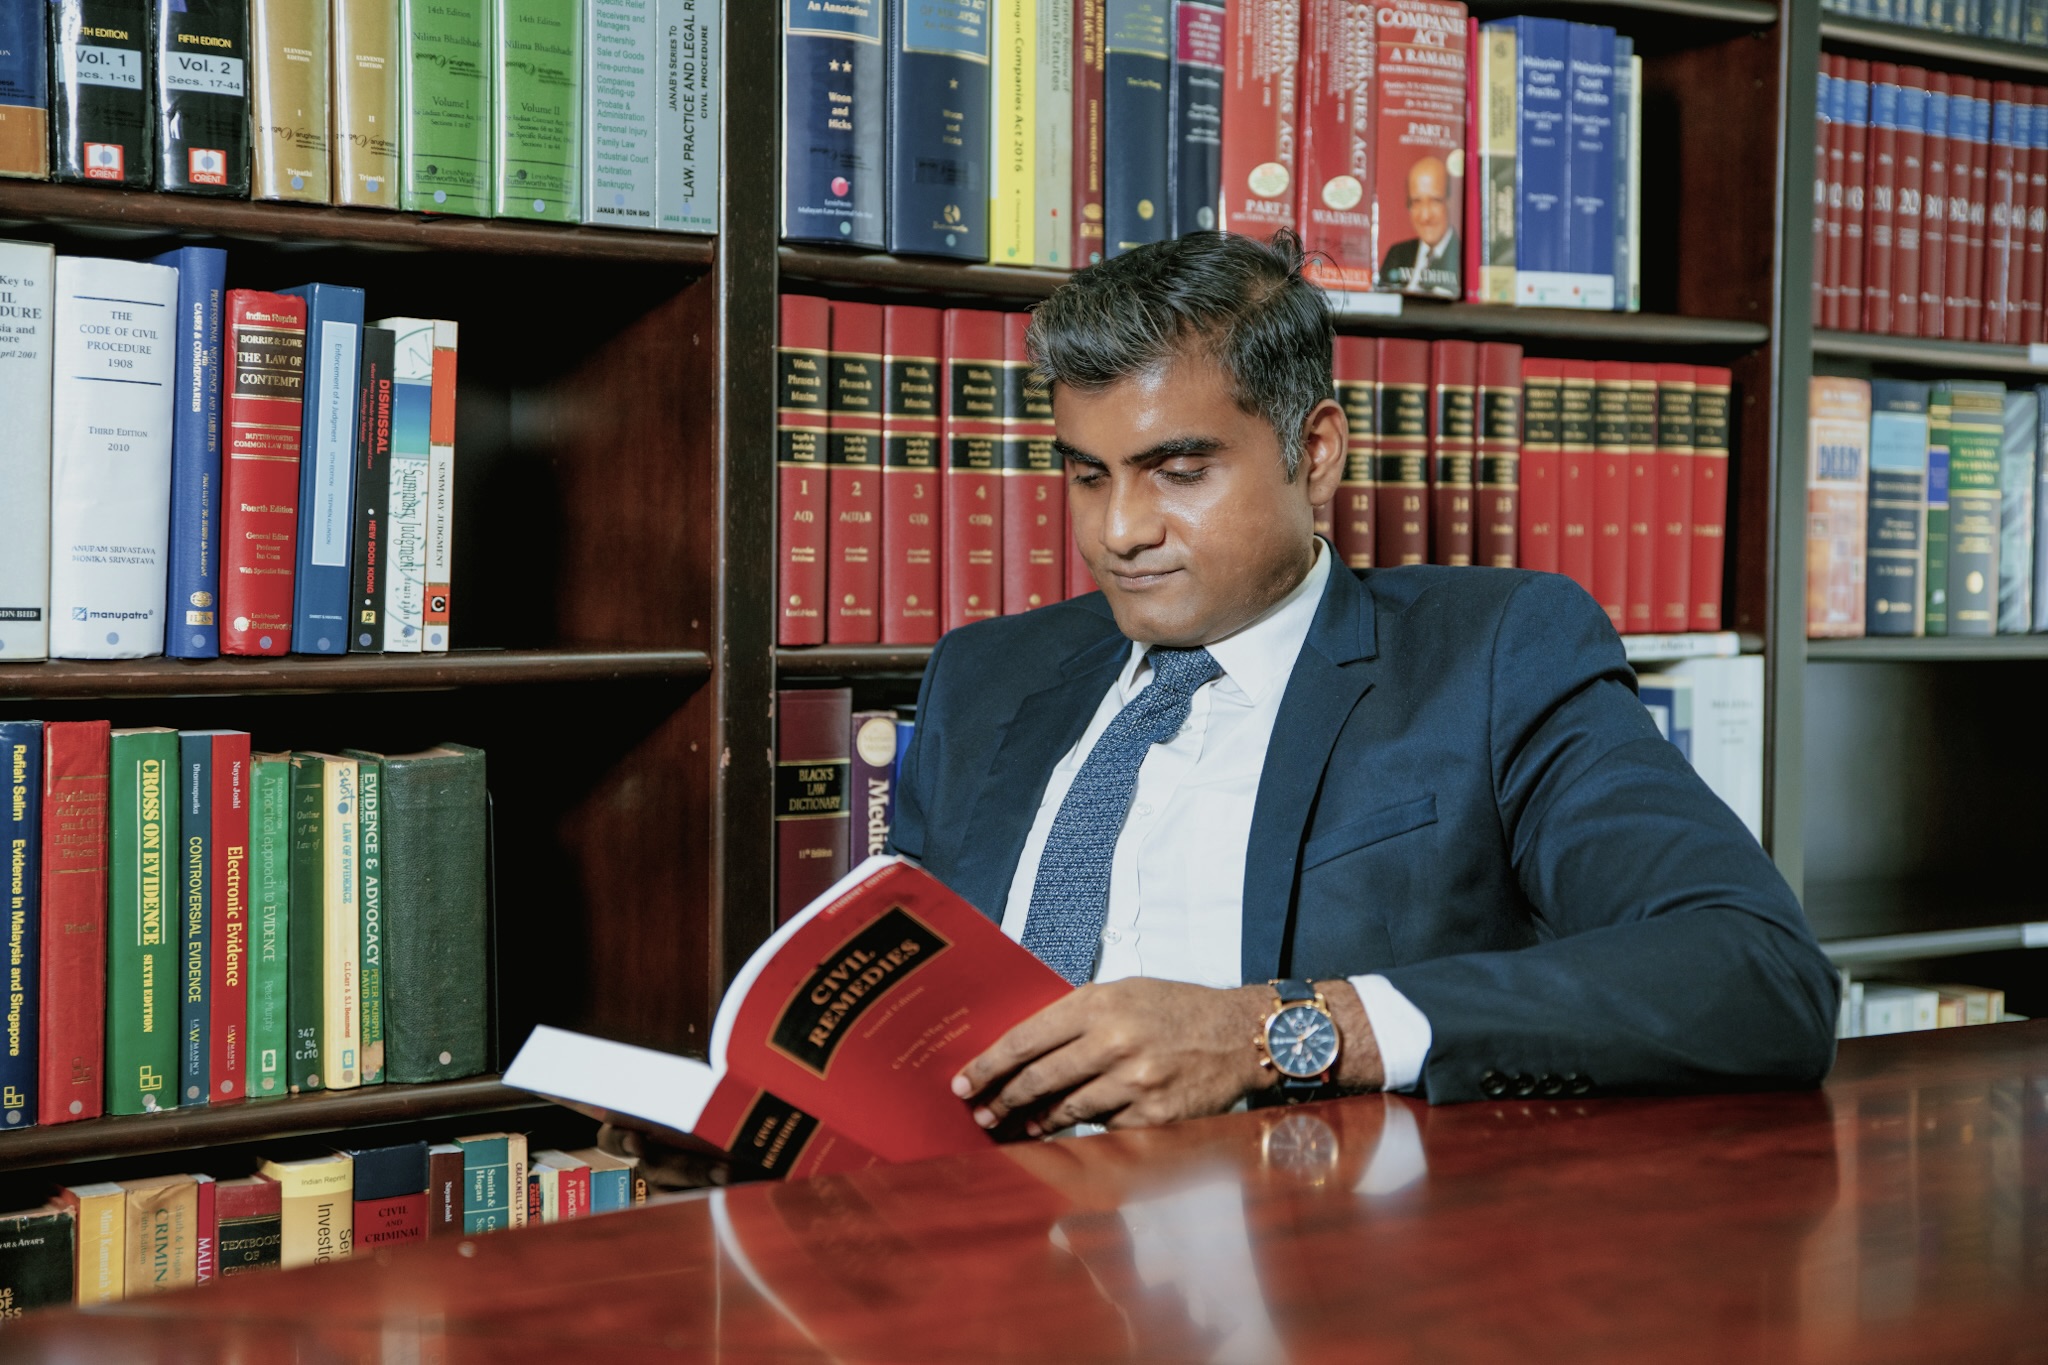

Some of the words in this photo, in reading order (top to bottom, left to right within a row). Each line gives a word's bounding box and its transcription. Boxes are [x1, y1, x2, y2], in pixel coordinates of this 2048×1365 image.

[597, 9, 631, 22] Receivers
[632, 15, 645, 24] and
[823, 2, 868, 18] Annotation
[596, 19, 630, 32] Managers
[95, 28, 128, 41] EDITION
[177, 33, 200, 45] FIFTH
[200, 35, 232, 49] EDITION
[597, 33, 636, 47] Partnership
[683, 14, 696, 59] LEGAL
[1412, 29, 1448, 49] ACT
[76, 50, 110, 66] Vol.
[118, 54, 126, 67] 1
[597, 47, 612, 57] Sale
[613, 48, 621, 58] of
[622, 50, 645, 61] Goods
[668, 38, 678, 70] SERIES
[700, 25, 709, 89] PROCEDURE
[178, 56, 214, 73] Vol.
[219, 62, 231, 75] 2
[597, 61, 645, 75] Hire-purchase
[1523, 55, 1565, 71] Malaysian
[1571, 59, 1613, 77] Malaysian
[109, 72, 136, 83] 1-16
[597, 75, 636, 88] Companies
[683, 61, 696, 92] AND
[1013, 37, 1024, 111] Companies
[168, 75, 203, 87] Secs.
[208, 79, 241, 91] 17-44
[597, 85, 636, 99] Winding-up
[828, 91, 852, 104] Woon
[432, 95, 465, 108] Volume
[521, 101, 552, 115] Volume
[597, 99, 624, 110] Probate
[700, 91, 709, 120] CIVIL
[597, 110, 645, 122] Administration
[831, 105, 849, 118] and
[597, 123, 628, 135] Personal
[628, 125, 648, 138] Injury
[683, 94, 696, 162] PRACTICE
[828, 118, 853, 131] Hicks
[1014, 114, 1024, 136] Act
[1408, 121, 1441, 138] PART
[597, 136, 620, 149] Family
[621, 139, 636, 149] Law
[597, 151, 628, 163] Industrial
[629, 153, 649, 164] Court
[1014, 140, 1024, 173] 2016
[89, 168, 119, 181] ORIENT
[193, 172, 222, 184] ORIENT
[597, 165, 632, 177] Arbitration
[597, 178, 635, 192] Bankruptcy
[596, 206, 615, 215] JANAB
[23, 276, 35, 288] to
[110, 310, 133, 322] THE
[193, 302, 203, 331] CASES
[245, 310, 271, 322] Indian
[271, 312, 298, 325] Reprint
[15, 325, 36, 336] and
[79, 323, 111, 336] CODE
[114, 326, 129, 337] OF
[132, 327, 159, 340] CIVIL
[87, 340, 153, 355] PROCEDURE
[239, 333, 274, 345] BORRIE
[274, 338, 281, 346] &
[281, 338, 303, 348] LOWE
[107, 357, 134, 369] 1908
[237, 351, 262, 364] THE
[265, 353, 288, 366] LAW
[289, 355, 303, 367] OF
[333, 343, 343, 390] Enforcement
[192, 340, 203, 413] COMMENTARIES
[239, 372, 301, 389] CONTEMPT
[332, 390, 342, 401] of
[329, 404, 339, 444] Judgment
[376, 379, 391, 455] DISMISSAL
[88, 426, 115, 436] THIRD
[116, 427, 148, 438] EDITION
[107, 442, 130, 452] 2010
[233, 439, 267, 449] COMMON
[268, 441, 282, 450] LAW
[437, 461, 447, 513] SUMMARY
[799, 479, 809, 496] 1
[851, 480, 862, 497] 2
[912, 483, 924, 500] 3
[975, 485, 986, 501] 4
[1036, 486, 1047, 502] 5
[240, 503, 268, 514] Fourth
[269, 504, 294, 515] Edition
[793, 510, 814, 524] A(I)
[367, 519, 377, 538] HEW
[435, 515, 445, 568] JUDGMENT
[72, 544, 109, 554] ANUPAM
[109, 546, 156, 556] SRIVASTAVA
[367, 538, 377, 566] SOON
[108, 556, 155, 566] SRIVASTAVA
[366, 566, 375, 594] KIONG
[16, 609, 38, 619] BHD
[89, 609, 149, 622] manupatra
[13, 744, 27, 784] Rafiah
[231, 761, 241, 787] Nayan
[264, 777, 275, 787] A
[798, 767, 835, 782] BLACK'S
[142, 759, 160, 821] CROSS
[807, 783, 827, 796] LAW
[12, 785, 27, 822] Salim
[788, 796, 841, 812] DICTIONARY
[261, 788, 276, 836] practical
[364, 772, 378, 855] EVIDENCE
[142, 823, 160, 849] ON
[342, 822, 352, 844] LAW
[342, 844, 352, 857] OF
[11, 839, 26, 895] Evidence
[261, 836, 276, 889] approach
[365, 858, 378, 870] &
[188, 836, 203, 939] CONTROVERSIAL
[226, 845, 244, 919] Electronic
[342, 858, 352, 905] EVIDENCE
[11, 896, 25, 910] in
[142, 852, 160, 946] EVIDENCE
[263, 891, 276, 903] to
[365, 875, 379, 966] ADVOCACY
[9, 911, 25, 966] Malaysia
[263, 905, 276, 963] EVIDENCE
[226, 922, 243, 987] Evidence
[142, 954, 153, 988] SIXTH
[188, 942, 202, 1004] EVIDENCE
[810, 947, 878, 1007] CIVIL
[10, 967, 24, 992] and
[361, 969, 370, 999] DAVID
[371, 968, 379, 998] PETER
[264, 980, 274, 1002] Peter
[808, 938, 921, 1050] REMEDIES
[142, 989, 153, 1033] EDITION
[262, 1001, 274, 1032] Murphy
[7, 993, 24, 1057] Singapore
[371, 1000, 380, 1039] MURPHY
[298, 1027, 315, 1038] 347
[305, 1039, 317, 1050] 94
[301, 1177, 322, 1187] Indian
[323, 1174, 347, 1185] Reprint
[475, 1169, 486, 1202] Hogan
[486, 1168, 497, 1198] Smith
[515, 1162, 523, 1211] CRACKNELL'S
[487, 1198, 496, 1208] &
[378, 1205, 409, 1218] CIVIL
[385, 1218, 403, 1227] AND
[220, 1233, 281, 1251] TEXTBOOK
[365, 1227, 420, 1243] CRIMINAL
[243, 1250, 260, 1262] OF
